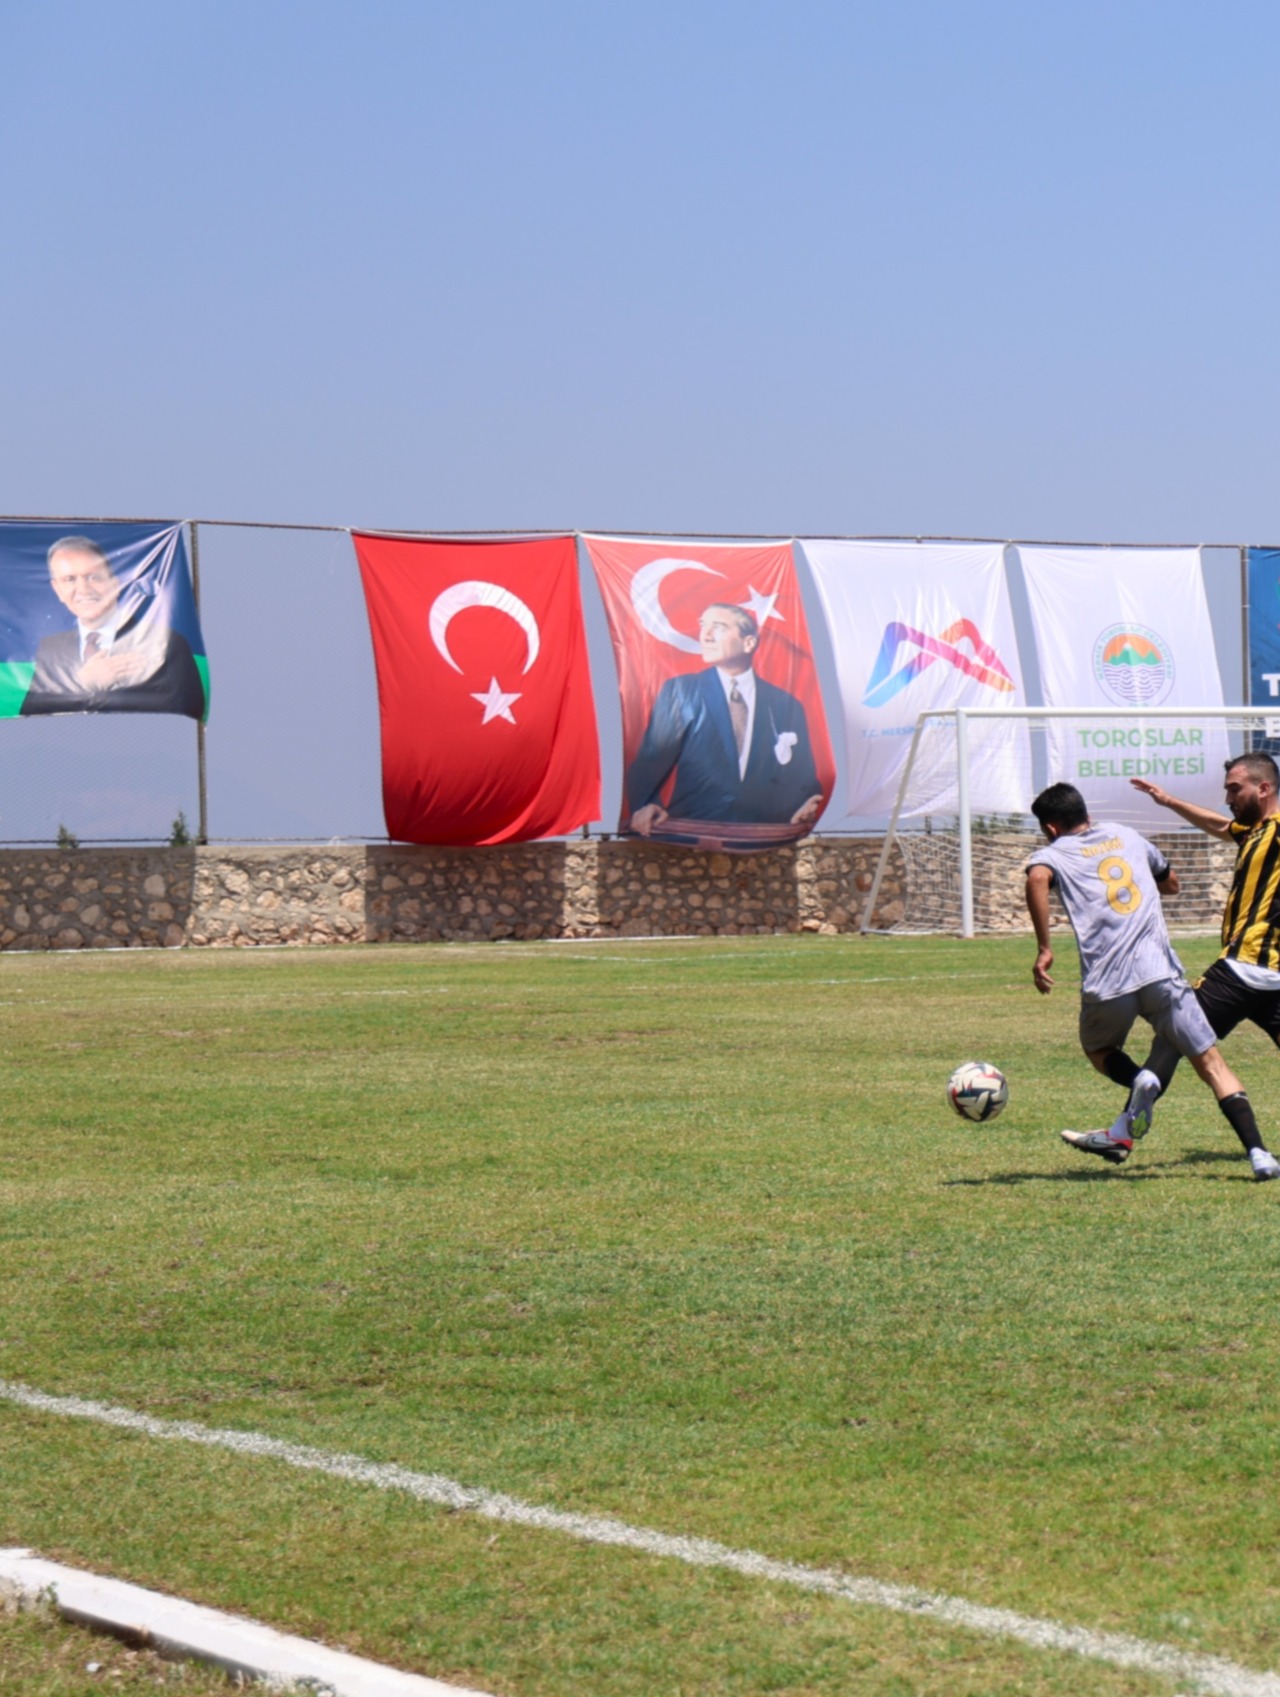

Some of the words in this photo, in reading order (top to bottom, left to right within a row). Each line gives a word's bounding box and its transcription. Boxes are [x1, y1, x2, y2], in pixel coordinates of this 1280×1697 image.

[1076, 727, 1204, 749] TOROSLAR
[1077, 751, 1205, 778] BELEDİYESİ
[1097, 856, 1143, 915] 8
